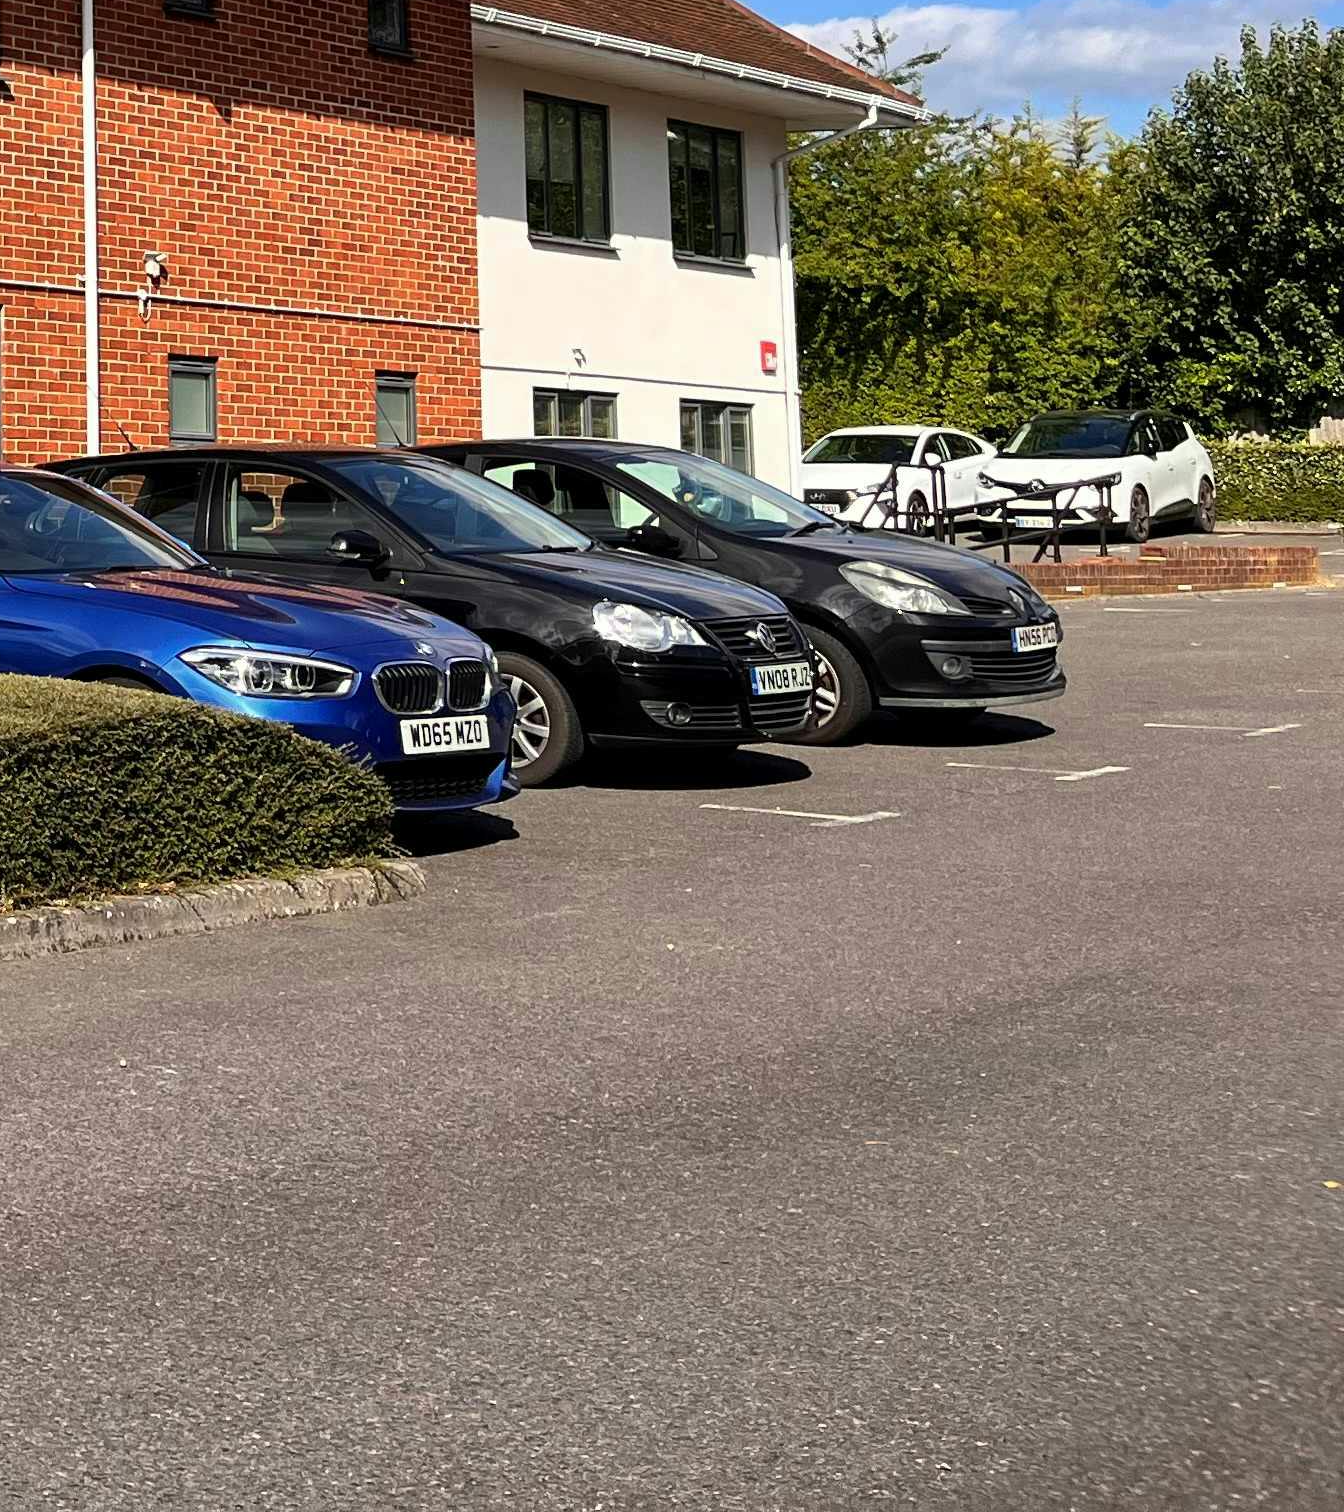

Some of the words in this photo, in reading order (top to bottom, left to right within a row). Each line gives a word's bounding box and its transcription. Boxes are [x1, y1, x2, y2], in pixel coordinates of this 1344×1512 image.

[759, 668, 790, 691] VN08
[791, 666, 810, 688] RJZ
[410, 721, 452, 748] WD65
